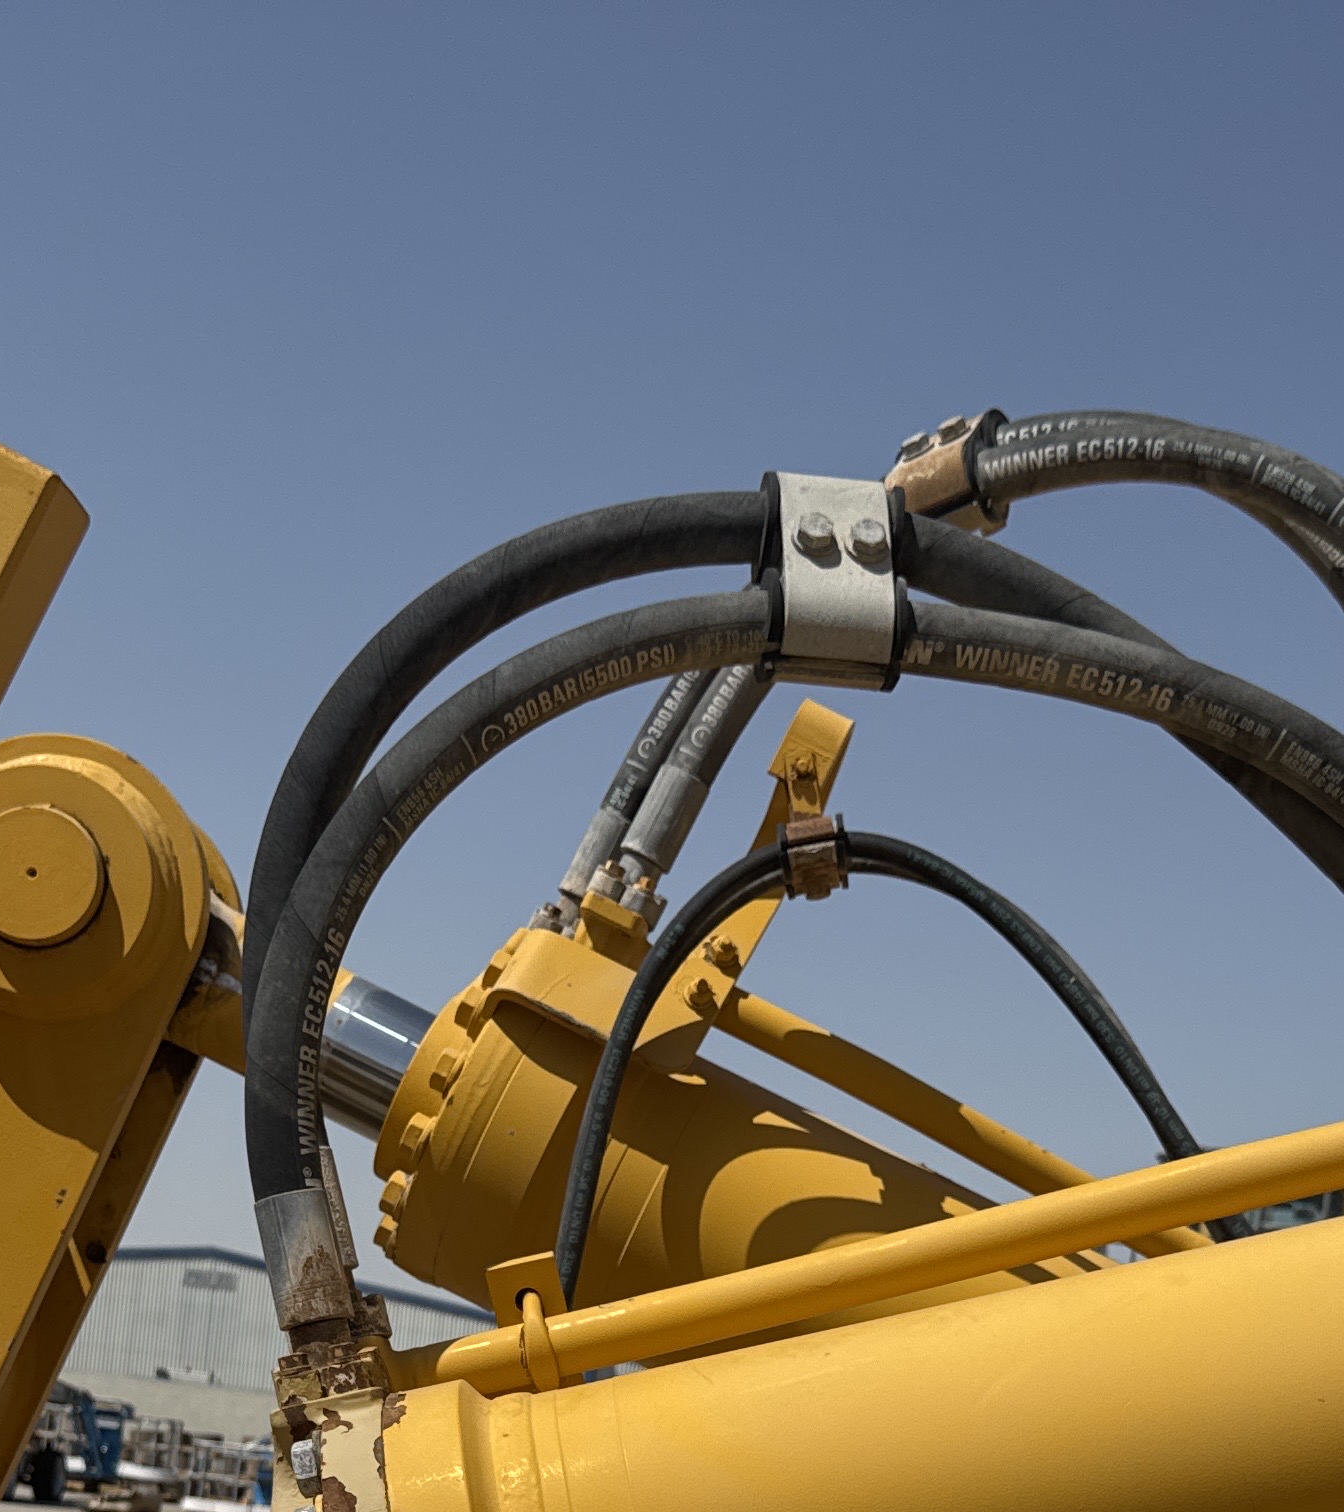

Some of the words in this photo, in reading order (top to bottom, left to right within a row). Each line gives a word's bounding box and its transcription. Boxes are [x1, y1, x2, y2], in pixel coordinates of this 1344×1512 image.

[984, 444, 1070, 482] WINNER
[1077, 438, 1166, 463] EC512-16
[636, 644, 675, 674] PSI)
[956, 644, 1059, 684] WINNER
[1066, 664, 1174, 712] EC512-16
[303, 928, 345, 1036] EC512-16
[616, 988, 646, 1041] WINNER
[298, 1046, 318, 1155] WINNER
